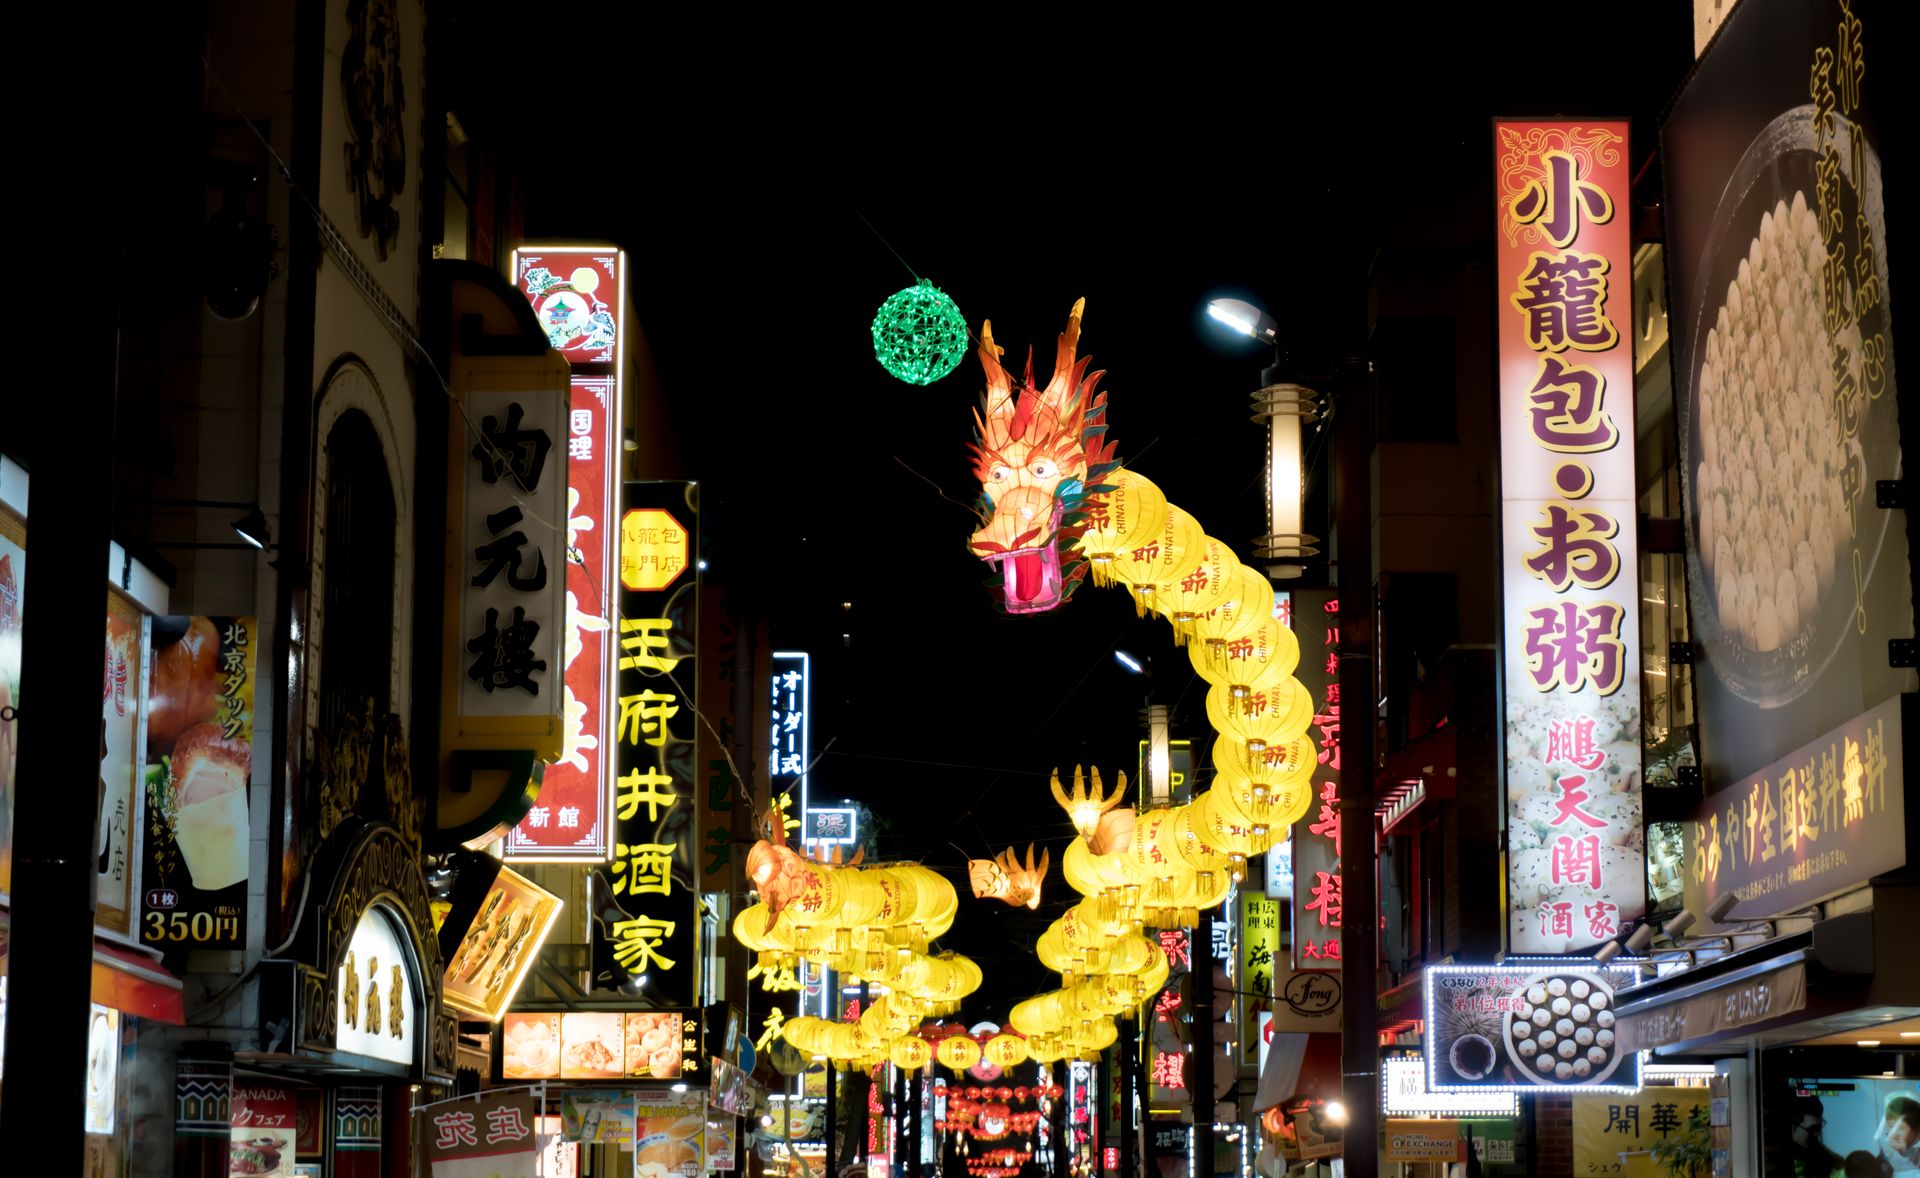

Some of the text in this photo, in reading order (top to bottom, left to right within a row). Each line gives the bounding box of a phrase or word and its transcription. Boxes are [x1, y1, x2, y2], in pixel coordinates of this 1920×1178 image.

[1511, 150, 1625, 696] 小籠包・お粥
[1115, 478, 1127, 535] CHINATOWN
[1164, 511, 1175, 566] CHINATOWN
[1210, 543, 1219, 596] CHINATOWN
[223, 623, 248, 739] 北京ダック
[781, 670, 802, 775] オーダー式
[613, 618, 680, 975] 王府井酒家
[1692, 718, 1888, 887] おみやげ全国送料無料
[529, 807, 580, 828] 新館
[151, 892, 175, 906] 1枚
[1247, 902, 1260, 929] 料理
[1262, 902, 1275, 928] 広東
[144, 911, 239, 942] 350円
[1541, 902, 1618, 939] 酒家
[1739, 984, 1772, 1019] レストラン
[232, 1088, 287, 1101] CANADA
[1406, 1140, 1454, 1149] EXCHANGE
